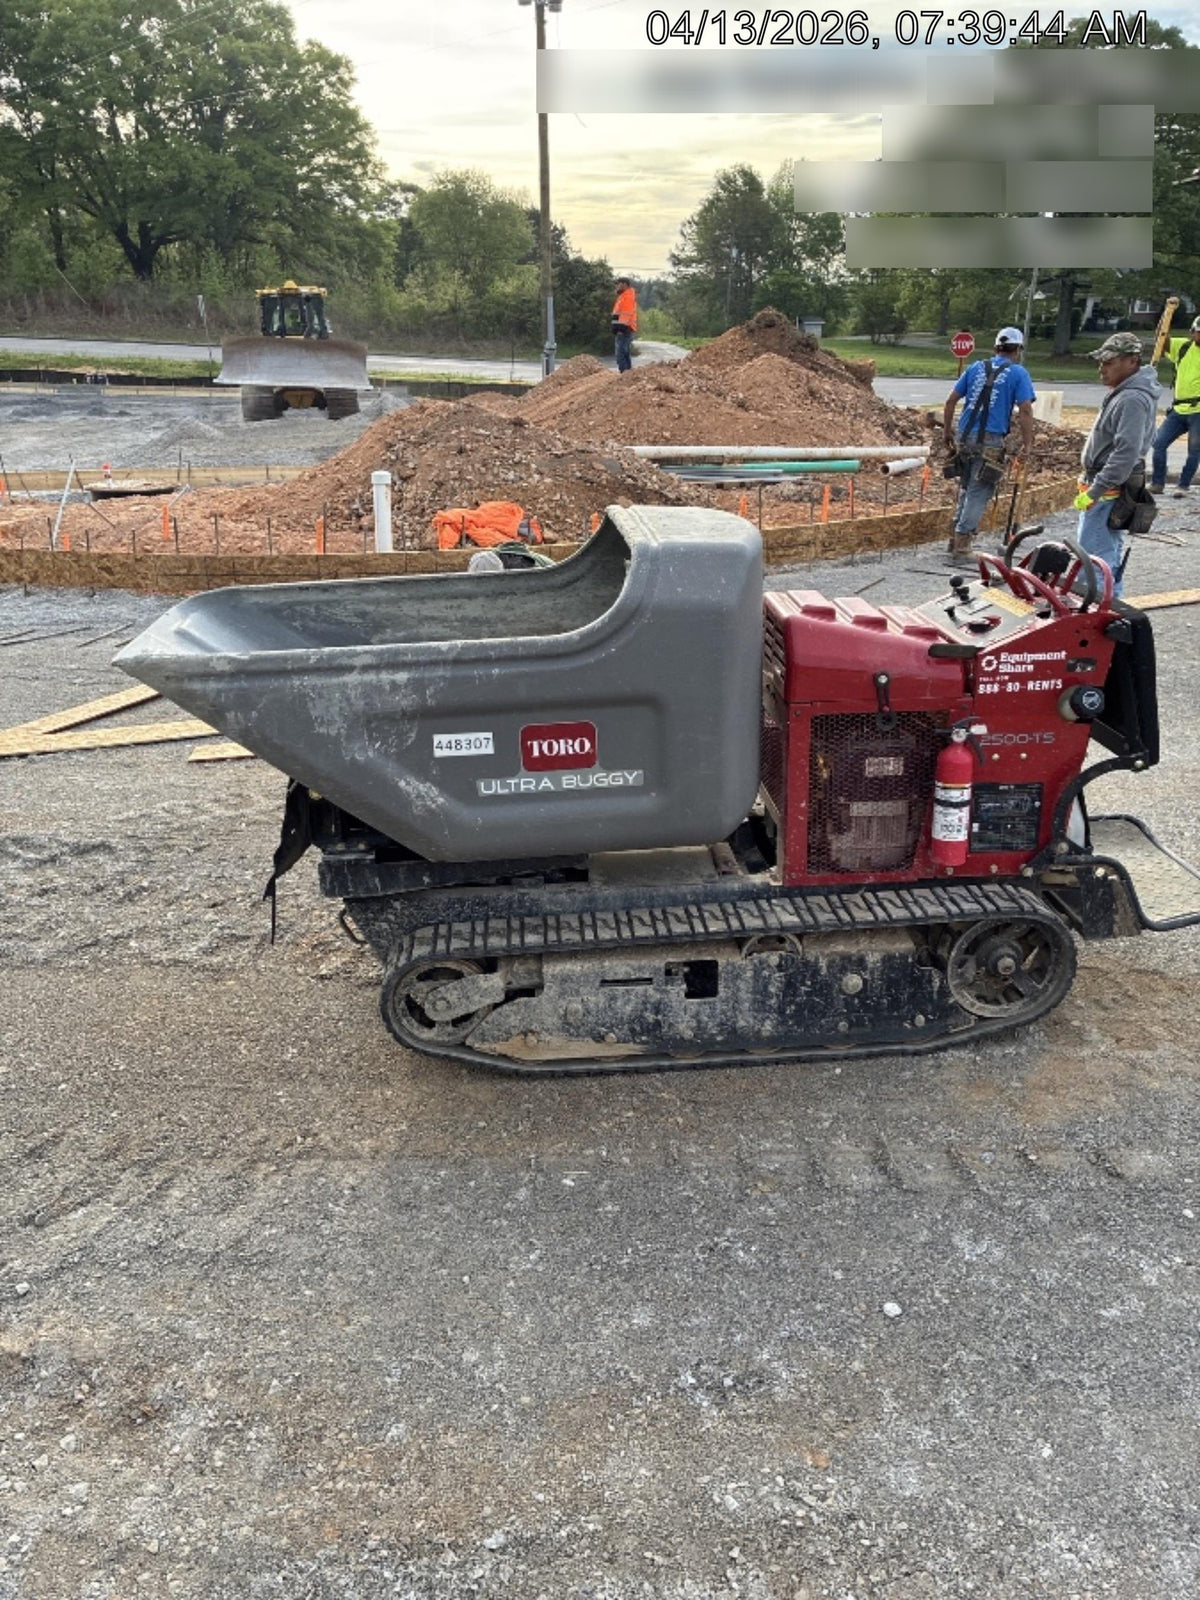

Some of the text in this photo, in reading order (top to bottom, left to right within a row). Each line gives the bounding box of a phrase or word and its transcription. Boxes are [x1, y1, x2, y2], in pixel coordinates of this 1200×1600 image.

[952, 340, 974, 350] STOP
[1000, 650, 1067, 663] Equipment
[998, 663, 1034, 673] Share
[434, 736, 492, 752] 448307
[527, 736, 592, 758] TORO
[480, 770, 640, 795] ULTRA BUGGY
